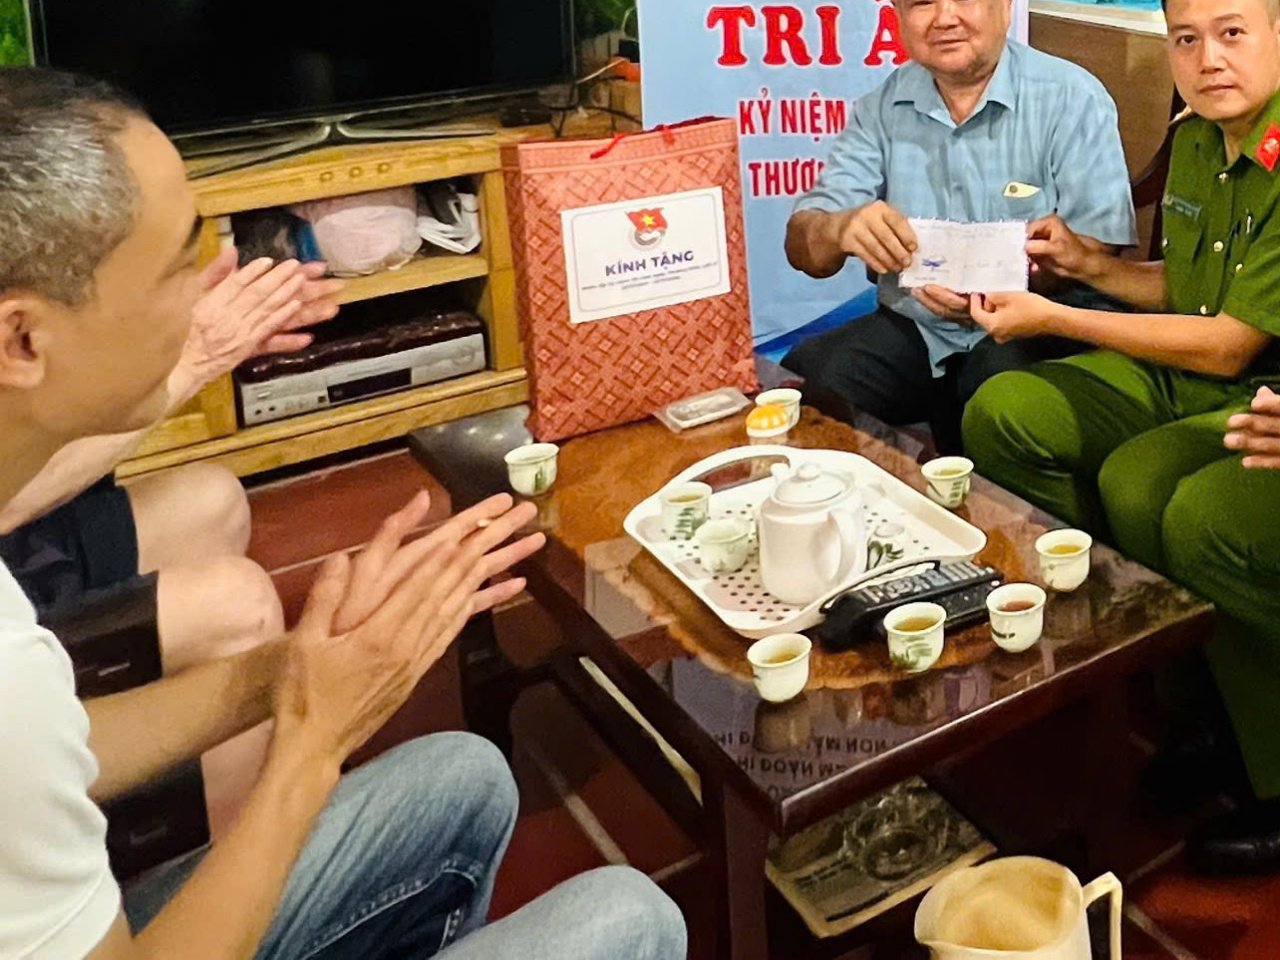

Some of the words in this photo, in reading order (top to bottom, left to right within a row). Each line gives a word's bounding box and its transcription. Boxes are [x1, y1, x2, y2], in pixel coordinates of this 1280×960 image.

[707, 5, 843, 66] TRI
[740, 87, 771, 134] KỶ
[781, 91, 845, 142] NIỆM
[748, 158, 826, 196] THƯƠ
[605, 259, 647, 276] KÍNH
[651, 250, 694, 269] TẶNG
